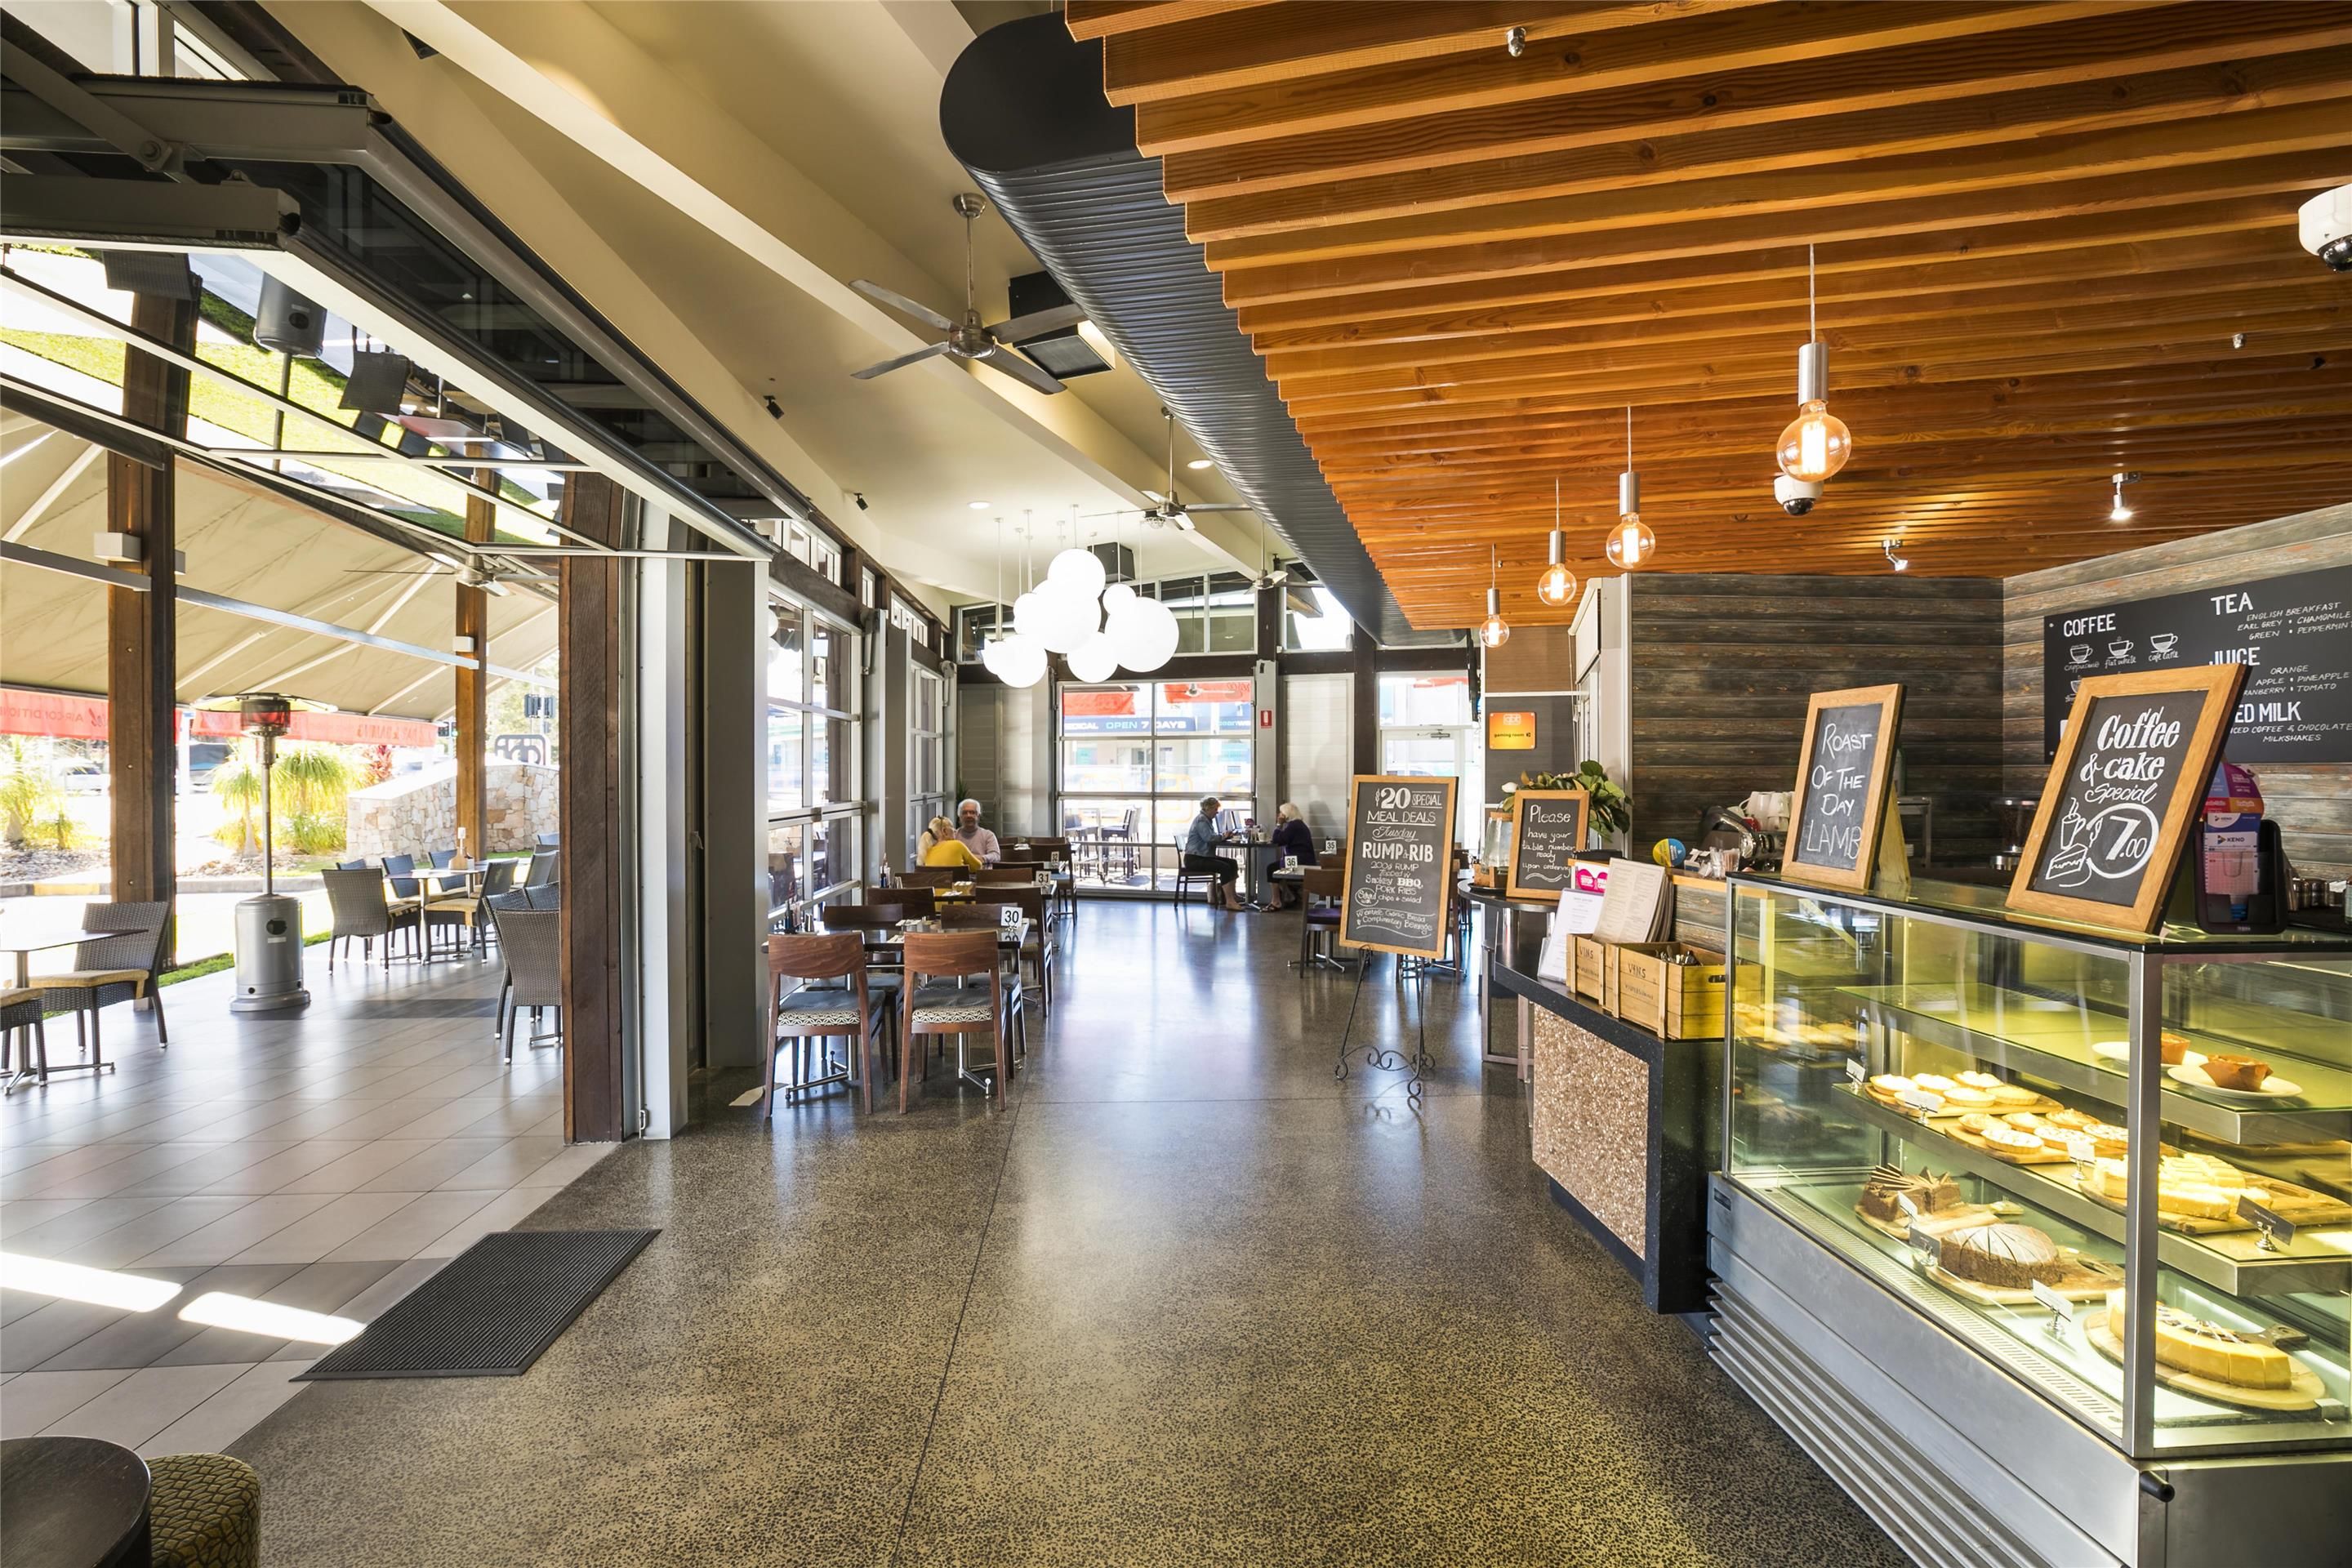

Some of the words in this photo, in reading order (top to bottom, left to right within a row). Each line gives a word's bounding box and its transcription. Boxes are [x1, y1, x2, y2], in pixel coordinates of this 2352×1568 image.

[2211, 592, 2253, 615] TEA
[2246, 610, 2283, 621] ENGLISH
[2285, 602, 2341, 616] BREAKFAST
[2064, 613, 2116, 637] COFFEE
[2237, 623, 2259, 631] EARL
[2261, 619, 2283, 628] GREY
[2296, 611, 2351, 624] CHAMOMILE
[2248, 630, 2280, 640] GREEN
[2209, 647, 2260, 666] JUICE
[2270, 665, 2309, 675] ORANGE
[2256, 677, 2284, 686] APPLE
[2296, 672, 2350, 683] PINEAPPLE
[2243, 686, 2286, 696] RANBERRY
[2296, 683, 2336, 693] TOMATO
[2259, 702, 2301, 723] MILK
[1105, 721, 1138, 729] OPEN
[1141, 721, 1149, 729] 7
[2097, 706, 2180, 751] Coffee
[2252, 725, 2283, 734] COFFEE
[2297, 723, 2352, 732] CHOCOLATE
[1821, 723, 1872, 759] ROAST
[2263, 734, 2322, 742] MILKSHAKES
[2080, 753, 2103, 786] &
[2104, 751, 2165, 781] cake
[1836, 766, 1865, 791] THE
[1411, 794, 1441, 806] SPECIAL
[2084, 782, 2158, 804] Special
[1820, 793, 1855, 817] DAY
[1367, 810, 1398, 822] MEAL
[1402, 811, 1436, 823] DEALS
[1530, 804, 1570, 822] Please
[1527, 827, 1548, 839] have
[1549, 832, 1572, 843] your
[1806, 819, 1862, 859] LAMB
[1362, 842, 1404, 860] RUMP
[1409, 844, 1433, 862] RIB
[1522, 840, 1544, 850] table
[1548, 843, 1575, 851] number
[1286, 858, 1296, 866] 36
[1536, 850, 1556, 862] ready
[1395, 862, 1419, 871] RUMP
[1522, 862, 1540, 871] upon
[1038, 873, 1049, 883] 31
[1365, 874, 1393, 885] Smokey
[1375, 884, 1396, 894] PORK
[1397, 886, 1417, 895] RIBS
[1004, 910, 1019, 924] 30
[1579, 946, 1594, 959] VINS
[1627, 963, 1646, 978] VINS
